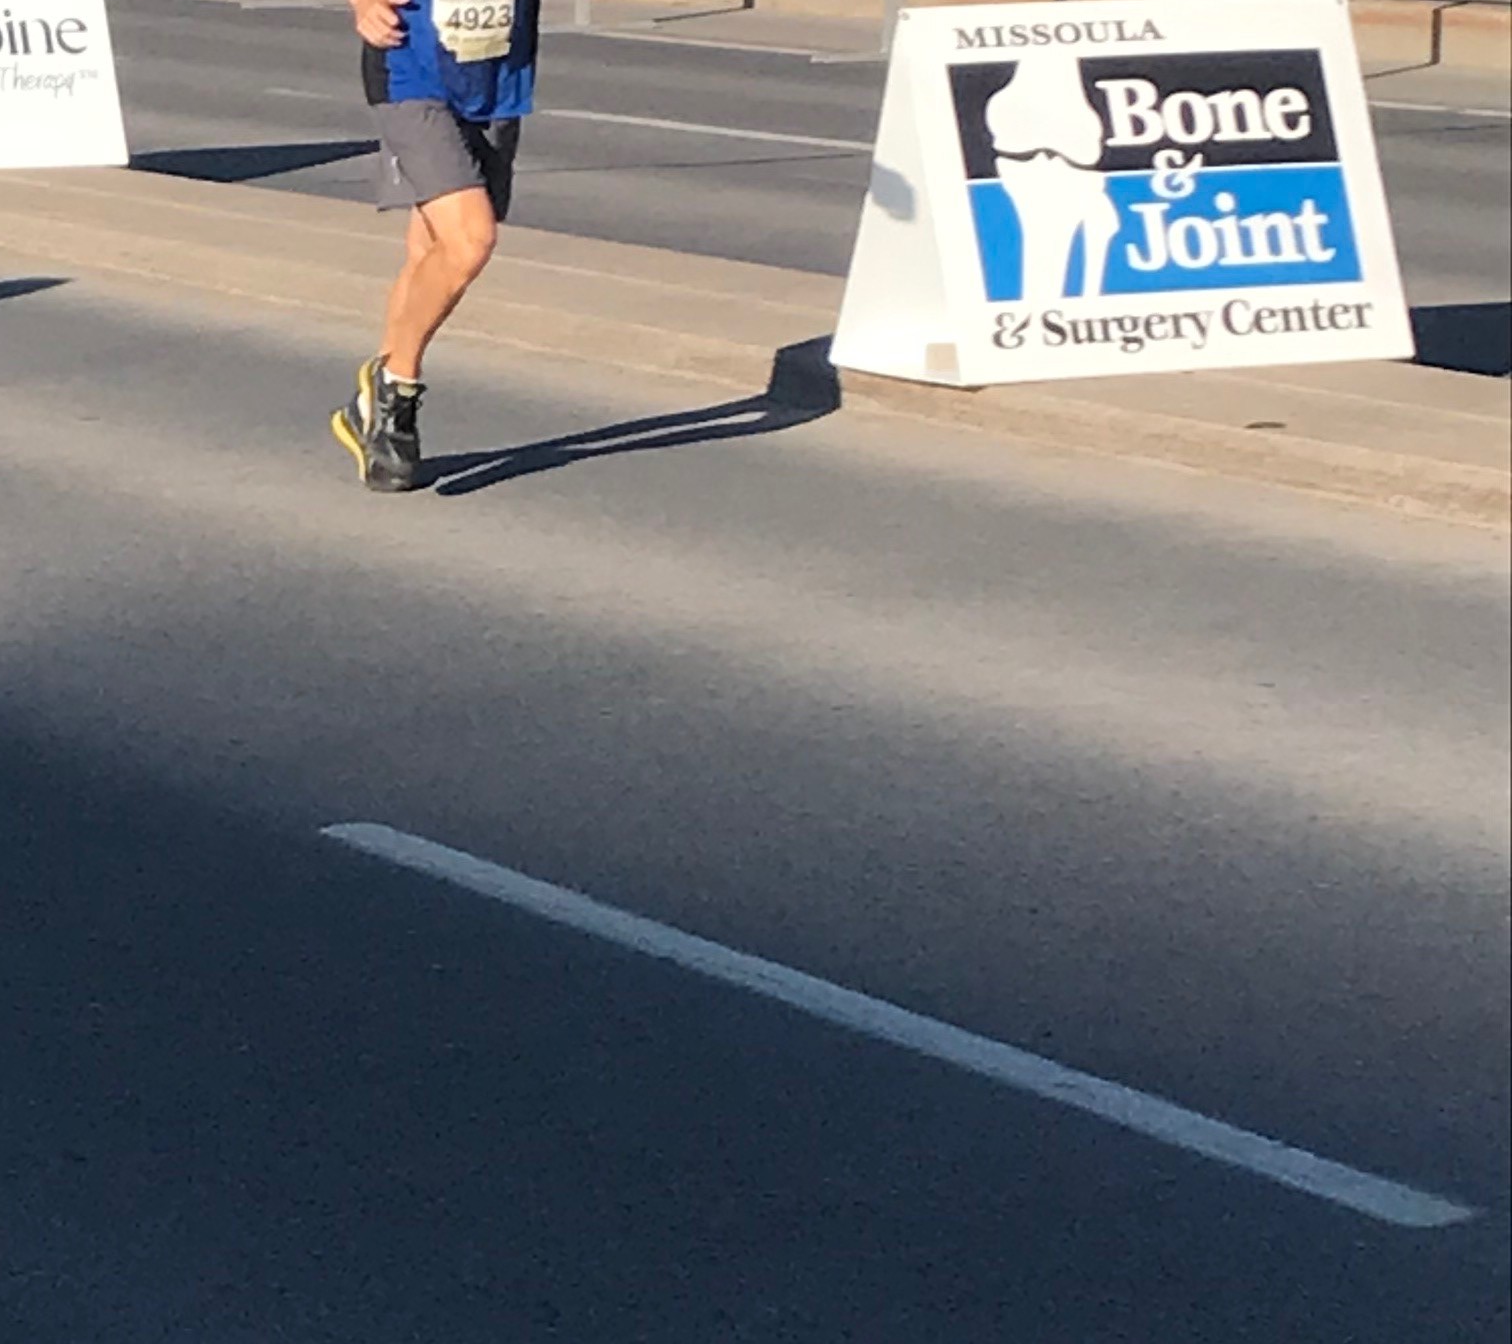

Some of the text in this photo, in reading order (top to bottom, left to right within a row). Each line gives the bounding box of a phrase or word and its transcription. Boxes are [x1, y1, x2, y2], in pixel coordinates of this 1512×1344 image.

[445, 3, 512, 31] 4923
[953, 19, 1166, 49] MISSOULA
[1094, 78, 1311, 147] Bone
[1150, 149, 1202, 199] &
[1125, 192, 1337, 272] Joint
[991, 299, 1375, 354] & Surgery Center
